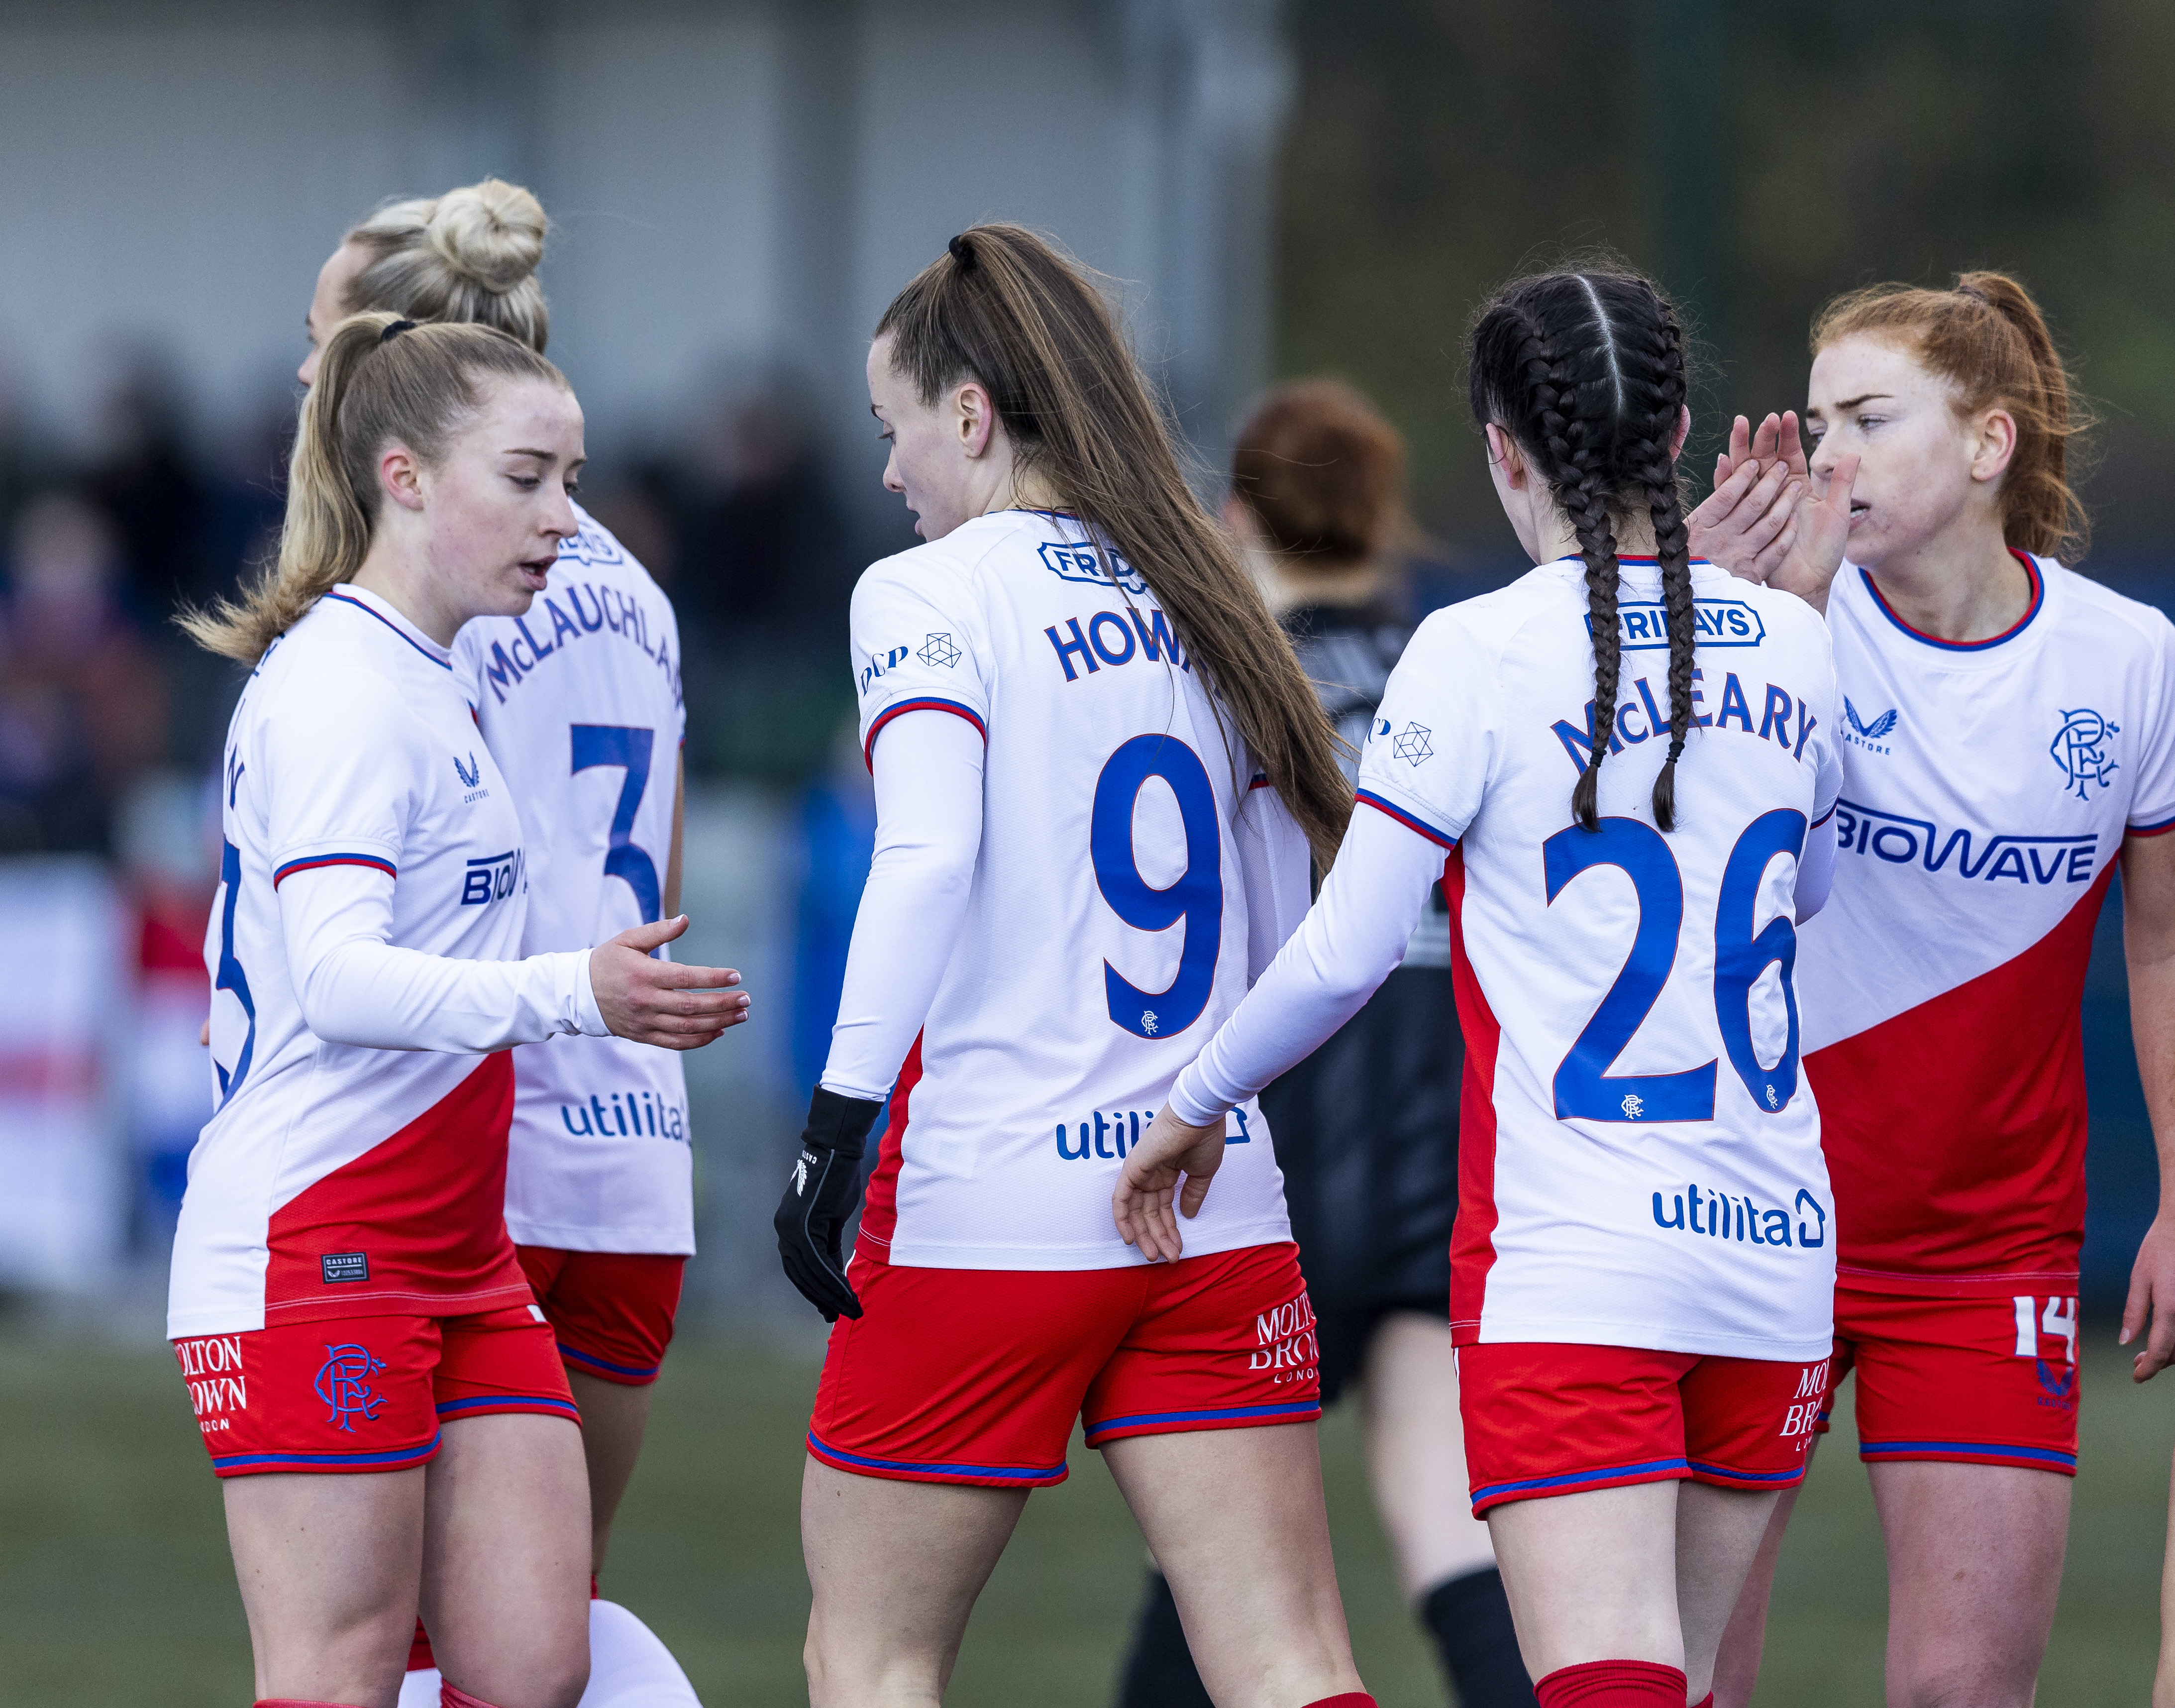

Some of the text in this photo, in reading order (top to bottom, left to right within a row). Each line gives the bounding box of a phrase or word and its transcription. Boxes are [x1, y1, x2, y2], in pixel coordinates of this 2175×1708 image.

[1617, 609, 1750, 640] RIAYS
[1549, 671, 1818, 777] McLEARY
[1844, 733, 1890, 756] ASTORE
[1835, 797, 2098, 885] BIOWAVE
[1090, 733, 1223, 1040] 9
[1543, 808, 1808, 1123] 26
[561, 1092, 682, 1141] utilita
[1652, 1183, 1792, 1247] utilita
[326, 1257, 362, 1266] CASTORE
[175, 1336, 242, 1377] OLTON
[2012, 1295, 2075, 1364] 14
[187, 1376, 246, 1415] OWN
